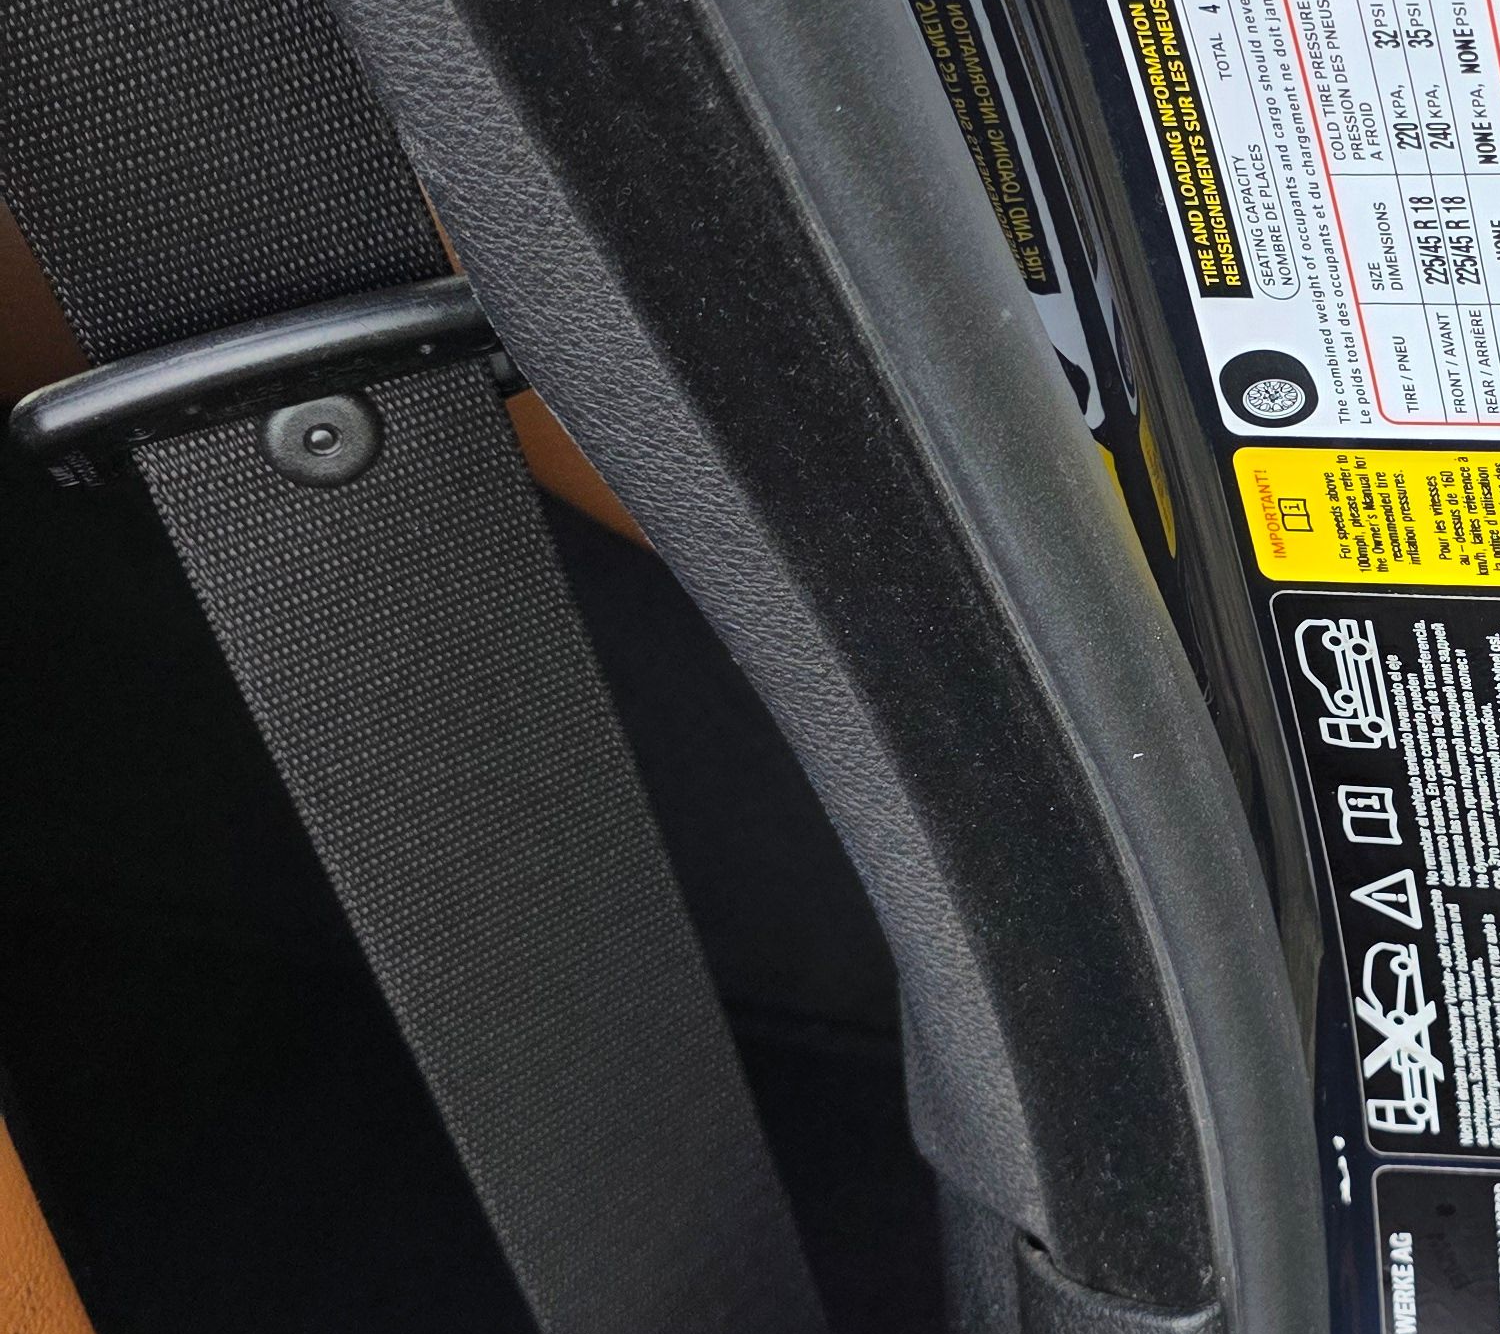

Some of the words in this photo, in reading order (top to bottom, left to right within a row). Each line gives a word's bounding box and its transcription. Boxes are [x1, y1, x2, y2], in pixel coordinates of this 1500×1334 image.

[1197, 3, 1222, 15] 4
[1368, 2, 1389, 29] PSI
[1404, 2, 1425, 28] PSI
[1450, 1, 1471, 27] PSI
[1208, 31, 1234, 82] TOTAL
[1267, 25, 1288, 59] doit
[1295, 0, 1329, 81] PRESSURE
[1370, 28, 1402, 50] 32
[1404, 27, 1436, 50] 35
[1451, 27, 1483, 75] NONE
[1127, 2, 1180, 128] INFORMATION
[1166, 59, 1191, 93] LES
[1246, 38, 1274, 93] should
[1278, 62, 1294, 82] ne
[1328, 53, 1350, 85] DES
[1177, 95, 1202, 133] SUR
[1264, 96, 1286, 140] cargo
[1315, 83, 1338, 119] TIRE
[1389, 83, 1410, 120] KPA,
[1424, 83, 1444, 120] KPA,
[1468, 82, 1489, 119] KPA,
[1282, 85, 1317, 177] chargement
[1325, 120, 1348, 162] COLD
[1336, 87, 1368, 162] PRESSION
[1357, 101, 1382, 148] FROID
[1391, 121, 1424, 151] 220
[1424, 121, 1456, 151] 240
[1273, 143, 1294, 172] and
[1368, 149, 1385, 163] A
[1470, 120, 1500, 166] NONE
[1164, 130, 1201, 207] LOADING
[1246, 143, 1274, 199] PLACES
[1230, 154, 1261, 225] CAPACITY
[1306, 180, 1323, 201] du
[1407, 195, 1436, 215] 18
[1439, 195, 1468, 215] 18
[1186, 209, 1212, 247] AND
[1187, 134, 1243, 287] RENSEIGNEMENTS
[1260, 201, 1279, 222] DE
[1284, 175, 1313, 252] occupants
[1311, 203, 1327, 220] et
[1412, 218, 1440, 231] R
[1443, 218, 1472, 231] R
[1249, 227, 1277, 288] SEATING
[1266, 223, 1295, 287] NOMBRE
[1300, 254, 1318, 272] of
[1317, 223, 1345, 299] occupants
[1372, 201, 1405, 292] DIMENSIONS
[1415, 234, 1451, 286] 225/45
[1447, 234, 1482, 286] 225/45
[1196, 248, 1221, 288] TIRE
[1366, 261, 1386, 292] SIZE
[1306, 274, 1330, 325] weight
[1335, 301, 1352, 328] des
[1339, 330, 1360, 364] total
[1434, 311, 1458, 359] AVANT
[1467, 308, 1493, 369] ARRIÈRE
[1317, 327, 1346, 396] combined
[1390, 335, 1413, 373] PNEU
[1444, 359, 1460, 367] /
[1399, 374, 1415, 382] /
[1478, 369, 1494, 377] /
[1401, 383, 1421, 415] TIRE
[1446, 368, 1469, 415] FRONT
[1481, 378, 1500, 415] REAR
[1336, 398, 1352, 426] The
[1358, 408, 1373, 425] Le
[1323, 472, 1340, 503] above
[1425, 475, 1444, 517] vitesses
[1253, 469, 1287, 559] IMPORTANT!
[1329, 505, 1350, 541] speeds
[1433, 519, 1447, 534] les
[1338, 543, 1353, 560] For
[1437, 537, 1453, 561] Pour
[1388, 1231, 1413, 1263] AG
[1390, 1263, 1417, 1334] WERKE
